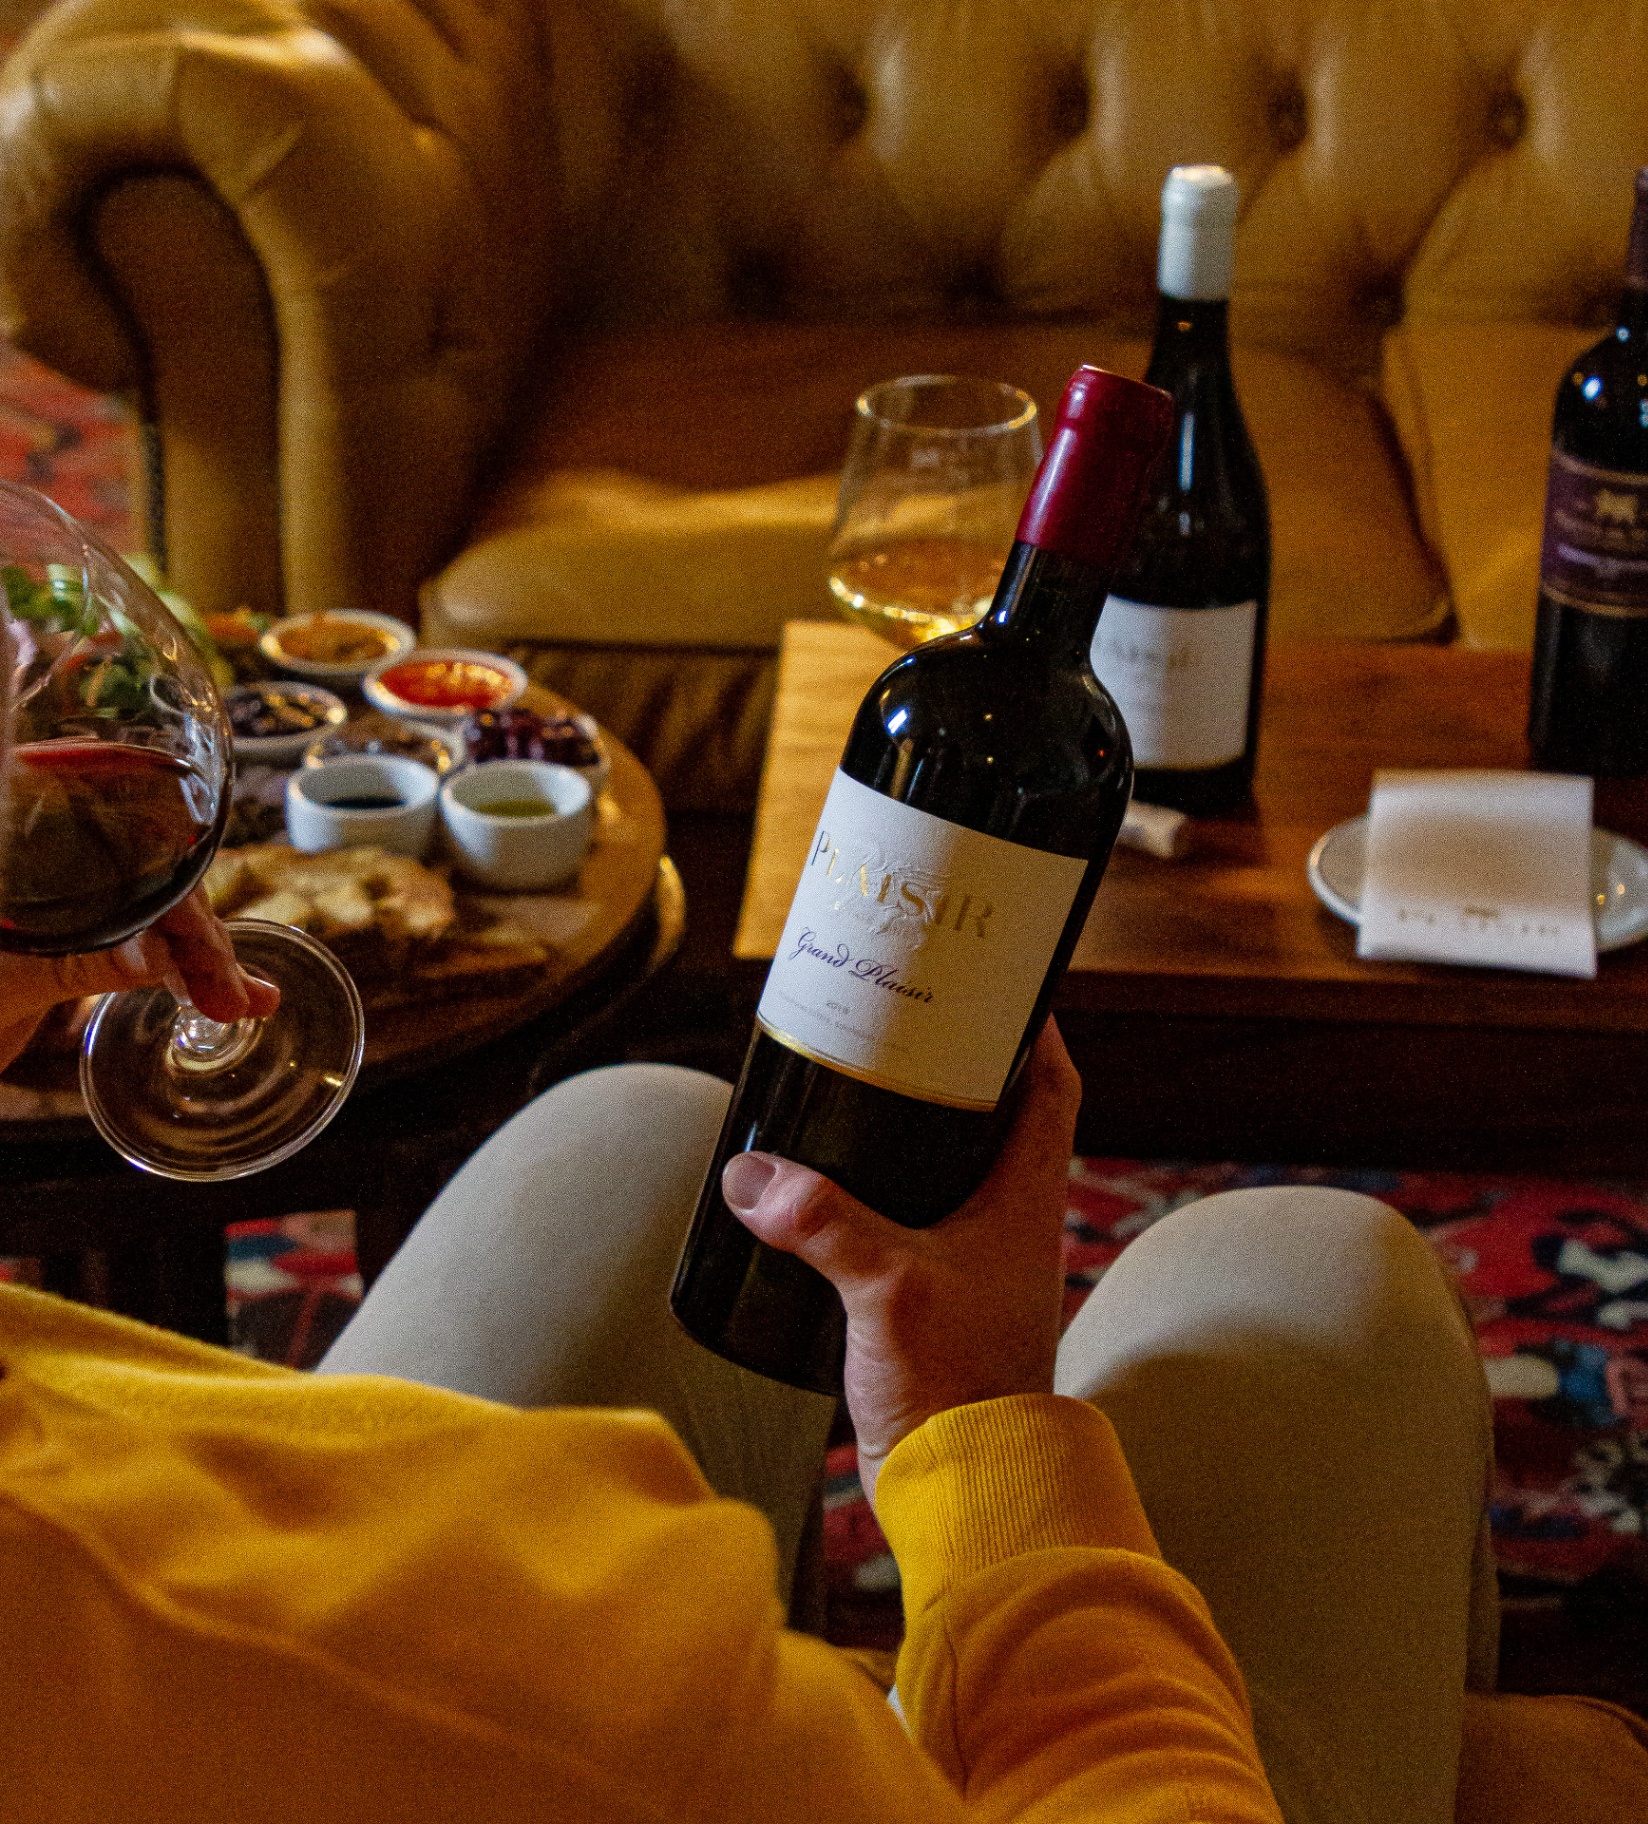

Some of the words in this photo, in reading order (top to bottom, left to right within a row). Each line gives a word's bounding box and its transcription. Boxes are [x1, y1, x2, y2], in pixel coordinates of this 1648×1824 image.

[810, 830, 994, 938] PLAISIR
[788, 927, 853, 969] Grand
[848, 958, 935, 1004] Plaisir
